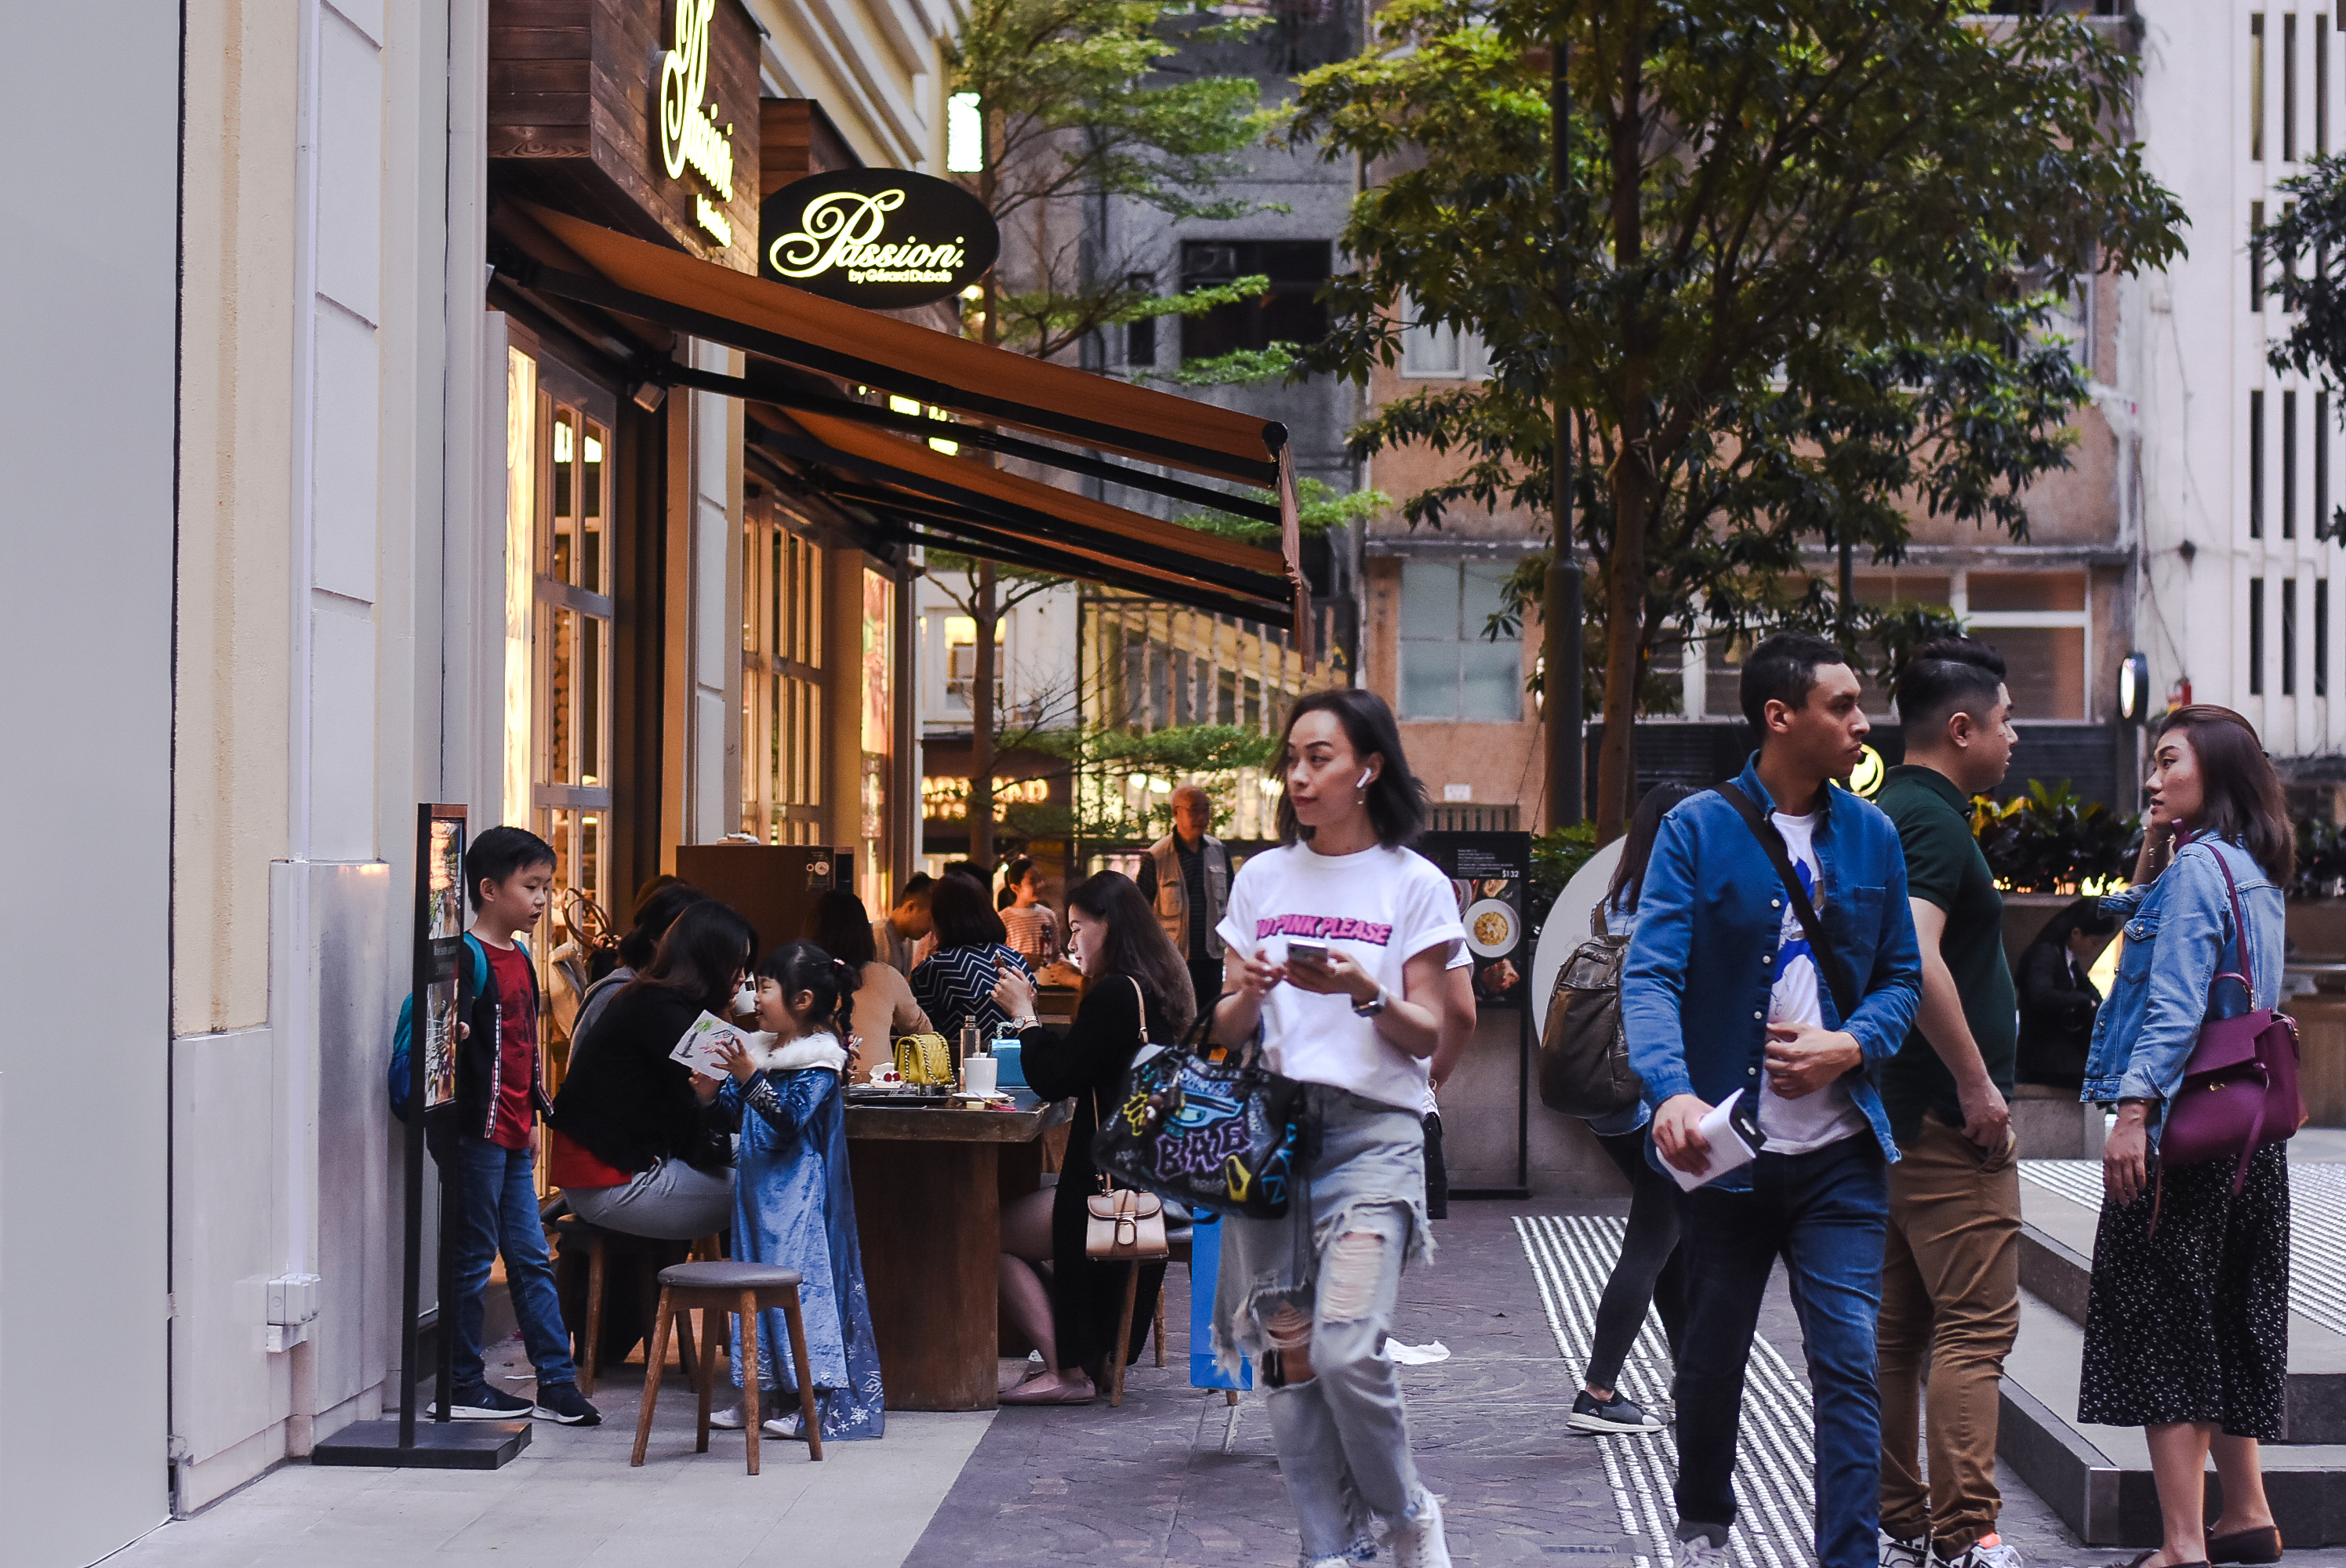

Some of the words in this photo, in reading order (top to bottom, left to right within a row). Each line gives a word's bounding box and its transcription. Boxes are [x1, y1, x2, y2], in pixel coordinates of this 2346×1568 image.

[848, 269, 866, 284] by
[910, 269, 953, 282] Dubois
[1502, 869, 1520, 878] $132
[1273, 914, 1324, 938] PINK
[1319, 917, 1393, 946] PLEASE
